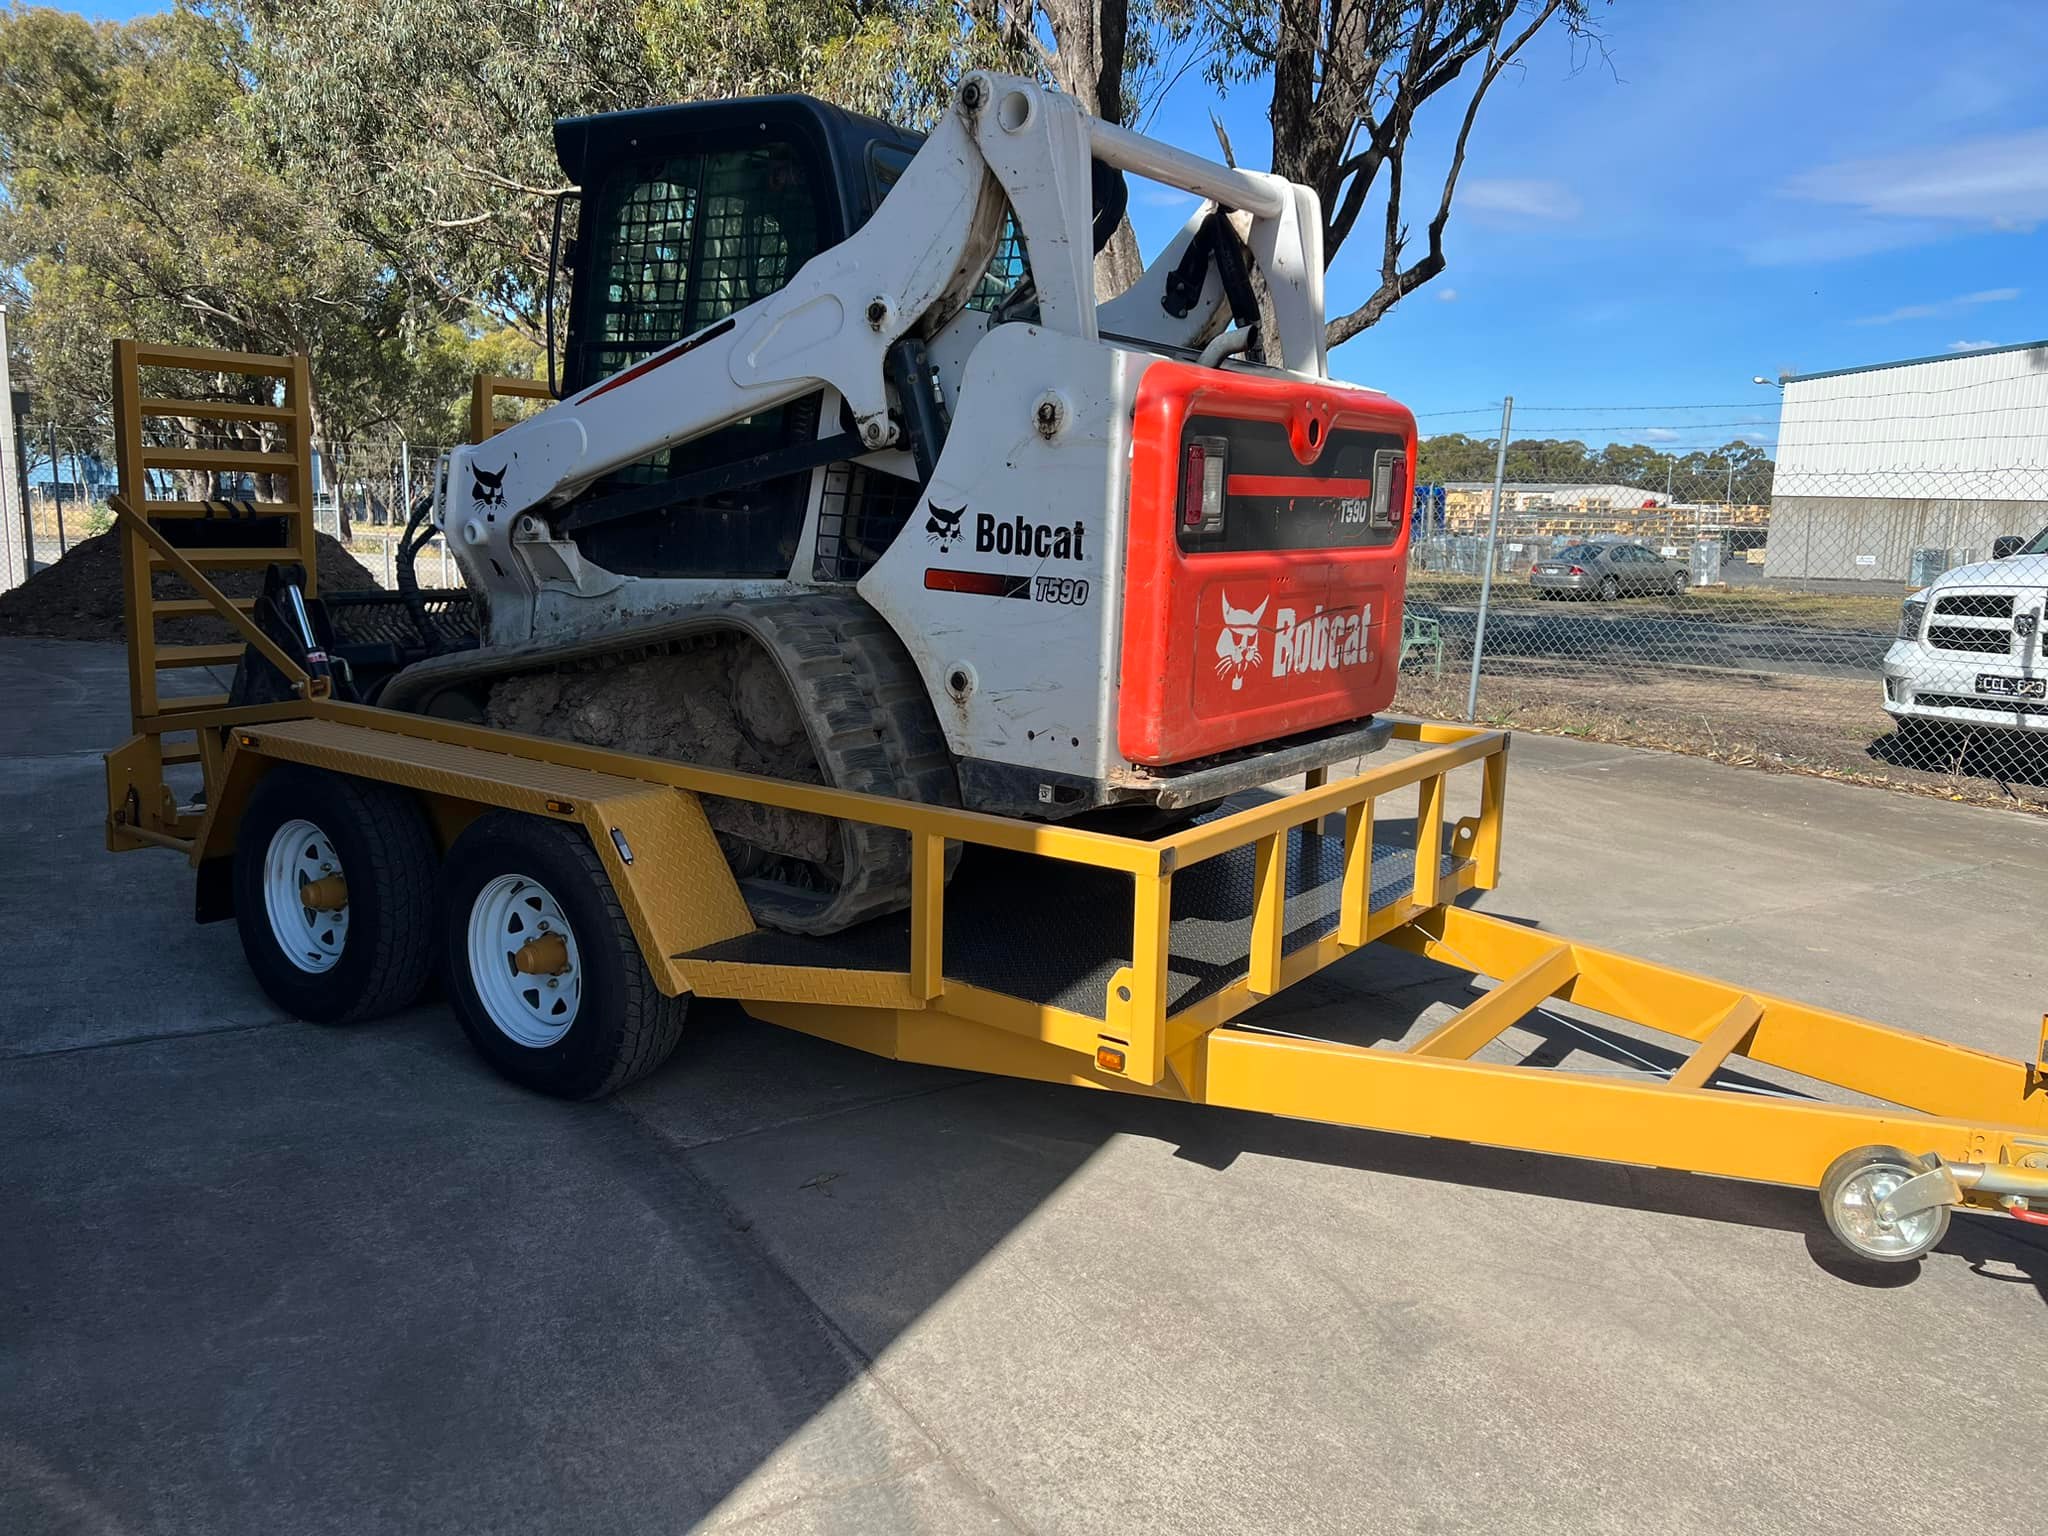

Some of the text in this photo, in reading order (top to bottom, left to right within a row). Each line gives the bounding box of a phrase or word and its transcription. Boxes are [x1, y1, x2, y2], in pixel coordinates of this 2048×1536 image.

[1340, 499, 1368, 524] T590
[975, 512, 1086, 561] Bobcat
[1035, 576, 1090, 606] T590
[1271, 602, 1373, 678] Bobcat
